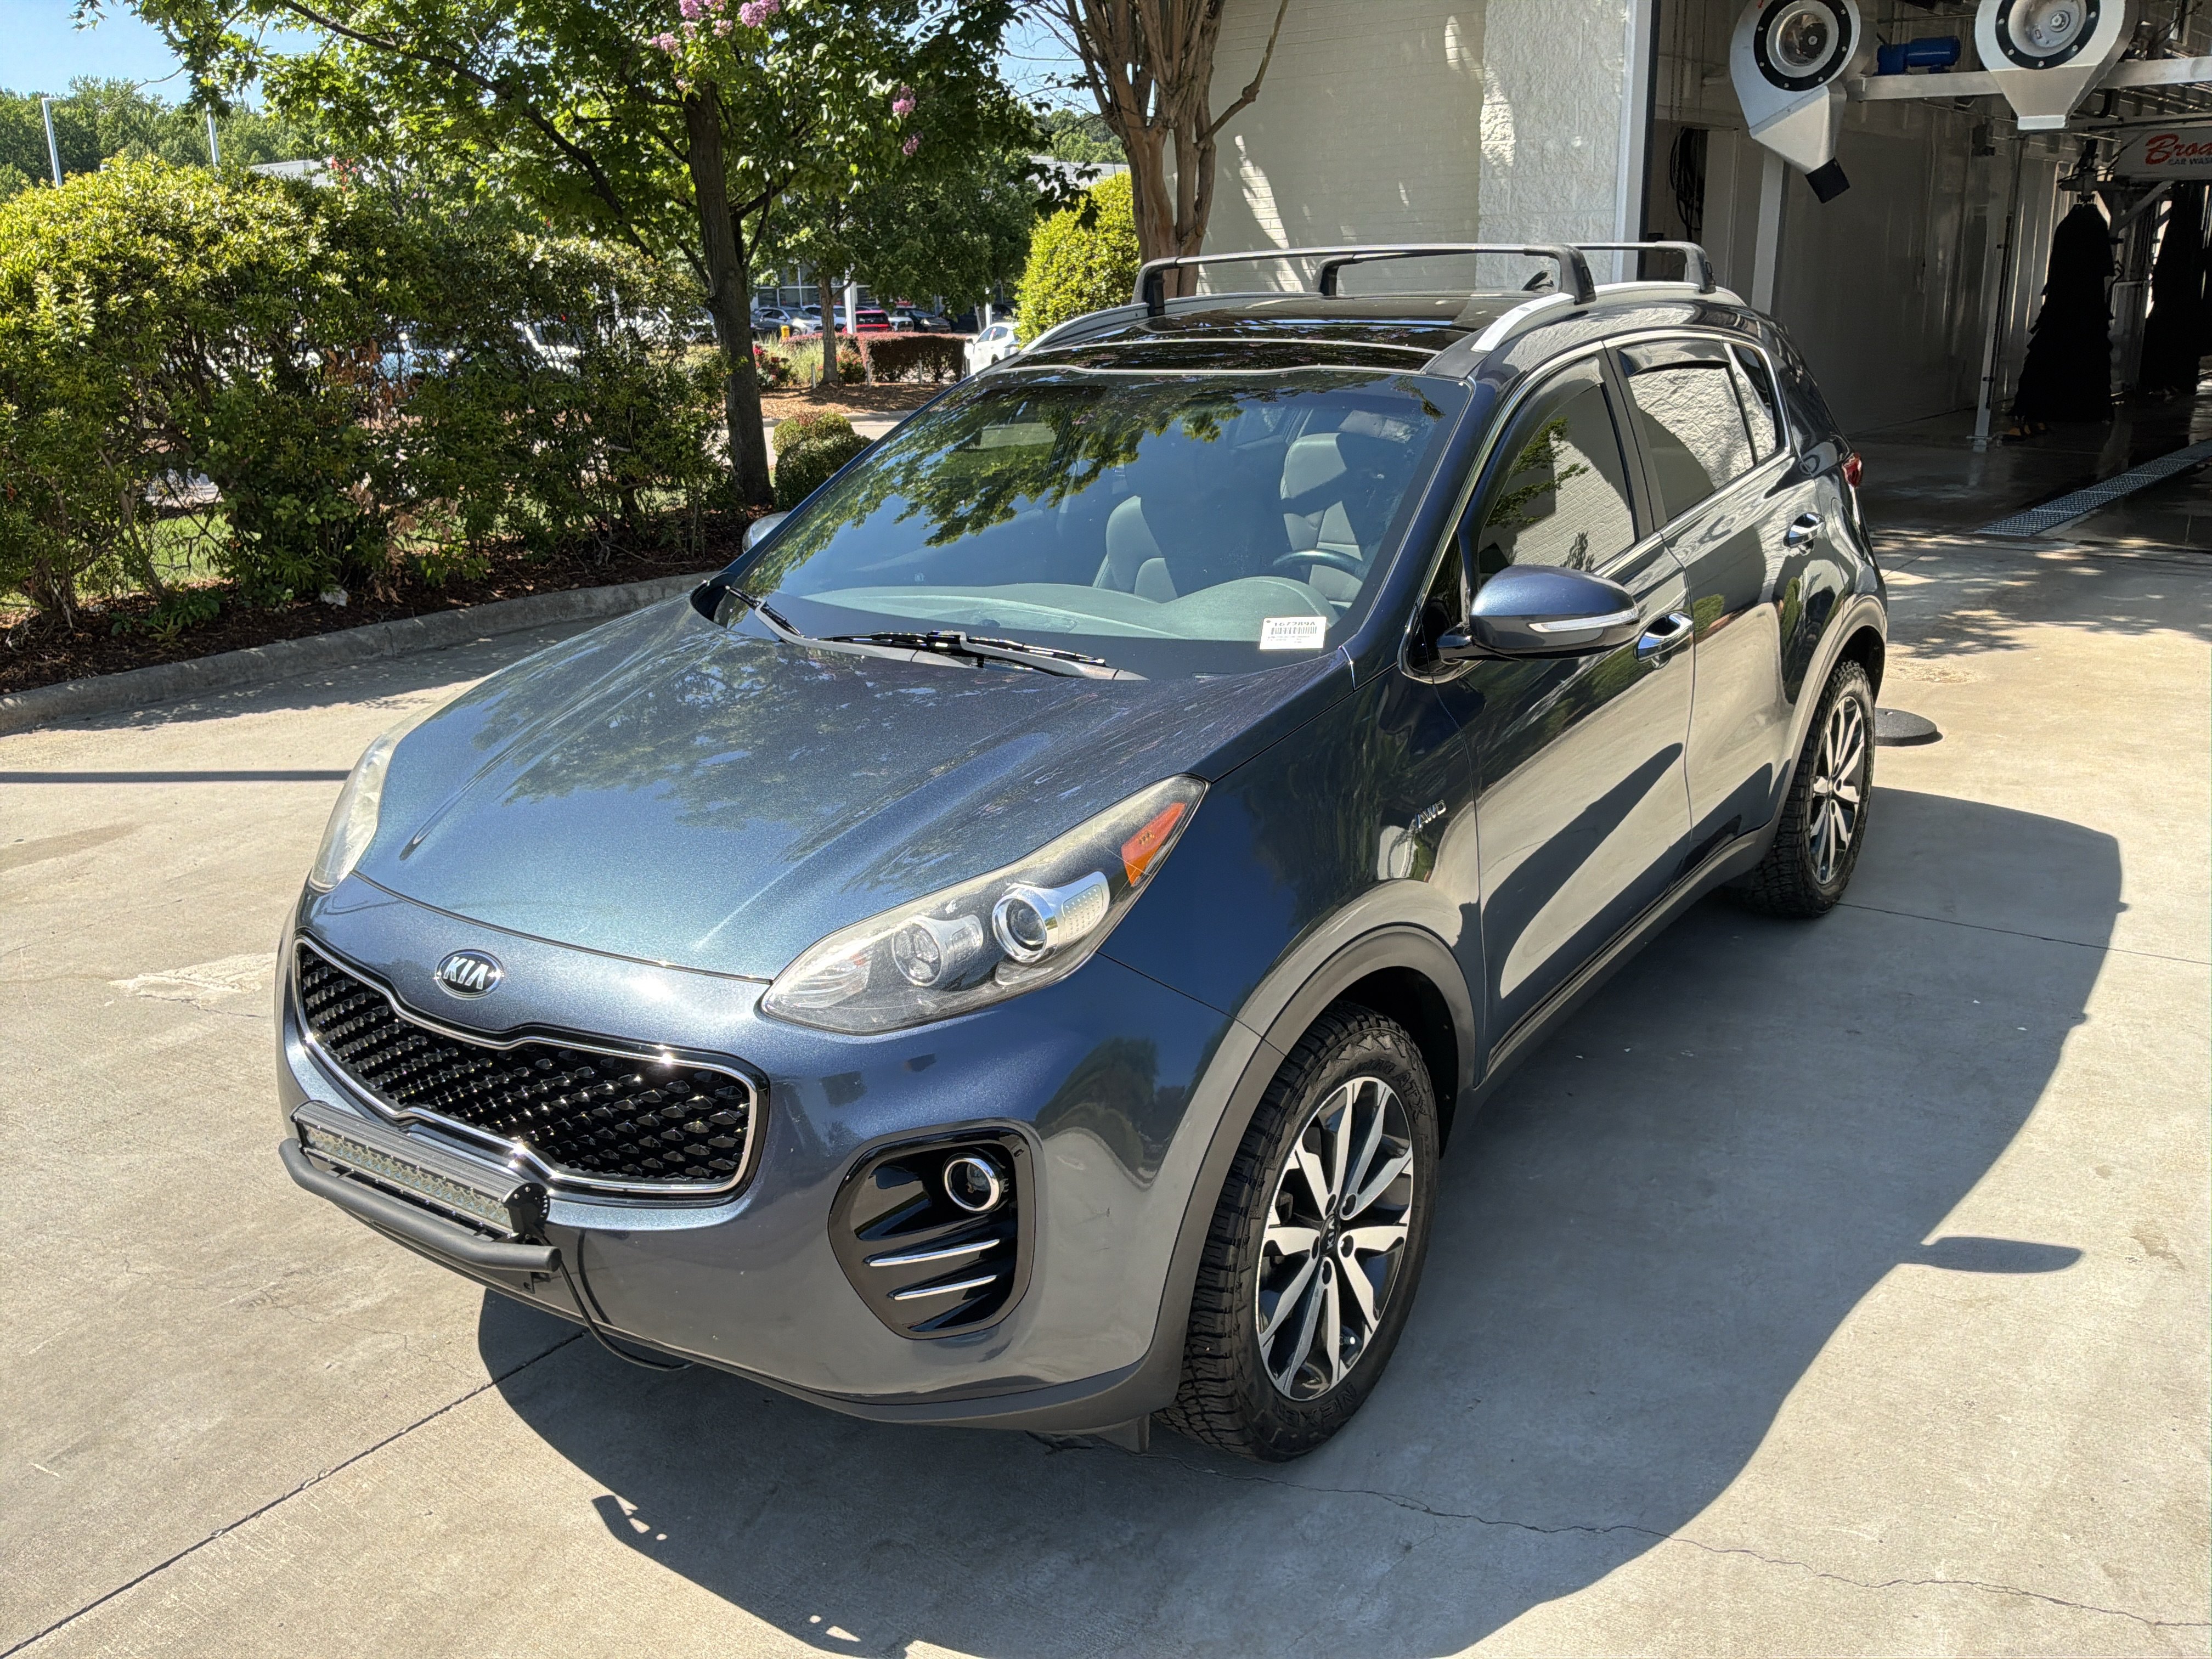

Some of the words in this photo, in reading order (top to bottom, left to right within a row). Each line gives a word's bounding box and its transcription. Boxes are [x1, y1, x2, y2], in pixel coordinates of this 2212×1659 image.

[1415, 799, 1447, 829] AWD
[443, 956, 489, 990] KIA
[1326, 1217, 1335, 1250] KIA
